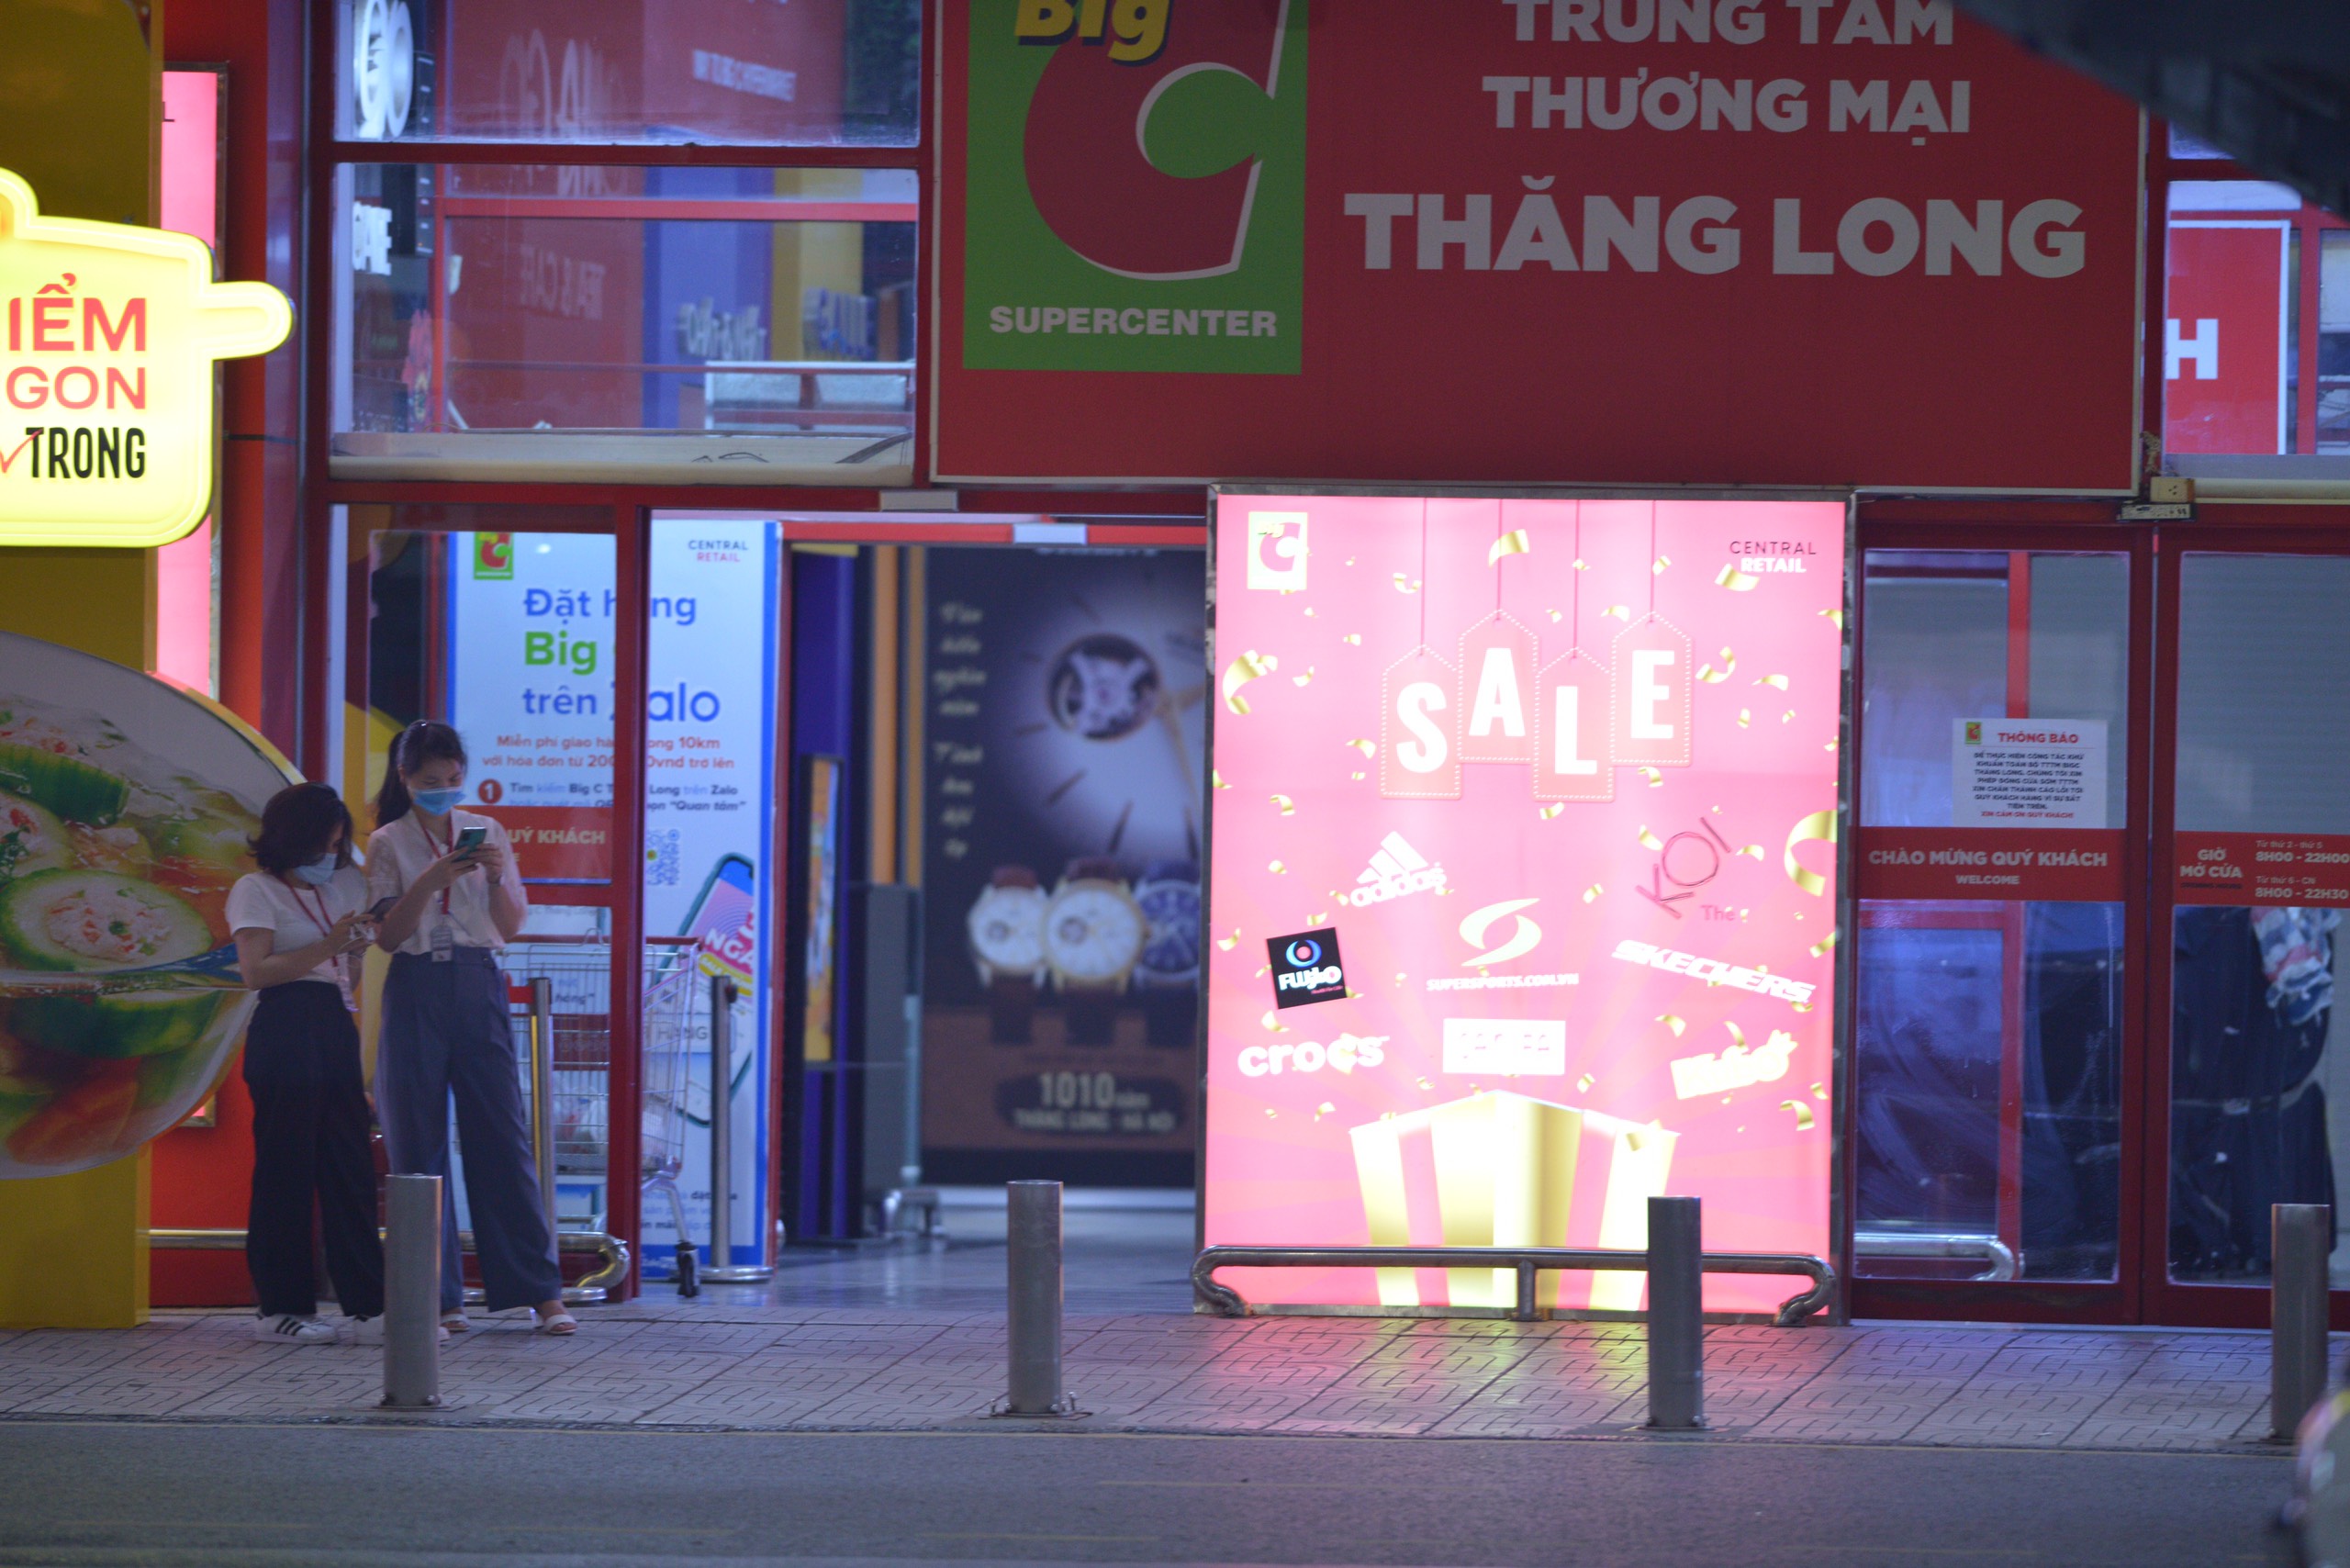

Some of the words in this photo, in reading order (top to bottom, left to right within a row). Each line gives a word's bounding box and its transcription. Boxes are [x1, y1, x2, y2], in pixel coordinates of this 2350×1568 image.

[1502, 0, 1766, 46] TRUNG
[1483, 67, 1808, 133] THƯƠNG
[1830, 79, 1971, 146] MẠI
[1344, 175, 1741, 275] THĂNG
[1773, 196, 2087, 279] LONG
[8, 273, 147, 353] IỂM
[990, 306, 1278, 337] SUPERCENTER
[2165, 318, 2219, 380] H
[6, 365, 147, 410] GON
[26, 426, 147, 479] TRONG
[688, 540, 748, 551] CENTRAL
[1729, 540, 1818, 556] CENTRAL
[697, 553, 741, 562] RETAIL
[1740, 558, 1807, 575] RETAIL
[523, 588, 591, 625] Đặt
[604, 588, 697, 627] hng
[525, 630, 598, 676] Big
[522, 684, 597, 714] trên
[610, 681, 722, 722] alo
[1395, 647, 1675, 775] SALE
[562, 736, 592, 750] giao
[678, 736, 721, 749] 10km
[1998, 729, 2046, 744] THÔNG
[2049, 732, 2079, 745] BÁO
[484, 783, 495, 801] 1
[569, 782, 589, 796] Big
[593, 784, 603, 794] C
[649, 784, 680, 796] Long
[711, 784, 739, 796] Zalo
[509, 826, 535, 844] UÝ
[537, 826, 606, 845] KHÁCH
[1868, 846, 1926, 866] CHÀO
[1929, 846, 1987, 866] MỪNG
[1990, 847, 2035, 867] QUÝ
[2037, 848, 2109, 868] KHÁCH
[2197, 846, 2227, 861] GIỜ
[2255, 851, 2294, 862] 8H00
[2304, 852, 2350, 864] 22H00
[1955, 874, 2020, 886] WELCOME
[2179, 861, 2206, 878] MỞ
[2208, 862, 2244, 879] CỬA
[2255, 887, 2293, 898] 8H00
[2304, 888, 2349, 900] 22H30
[1700, 904, 1736, 921] The
[1611, 939, 1817, 1003] SKECHERS
[1038, 1071, 1116, 1109] 1010
